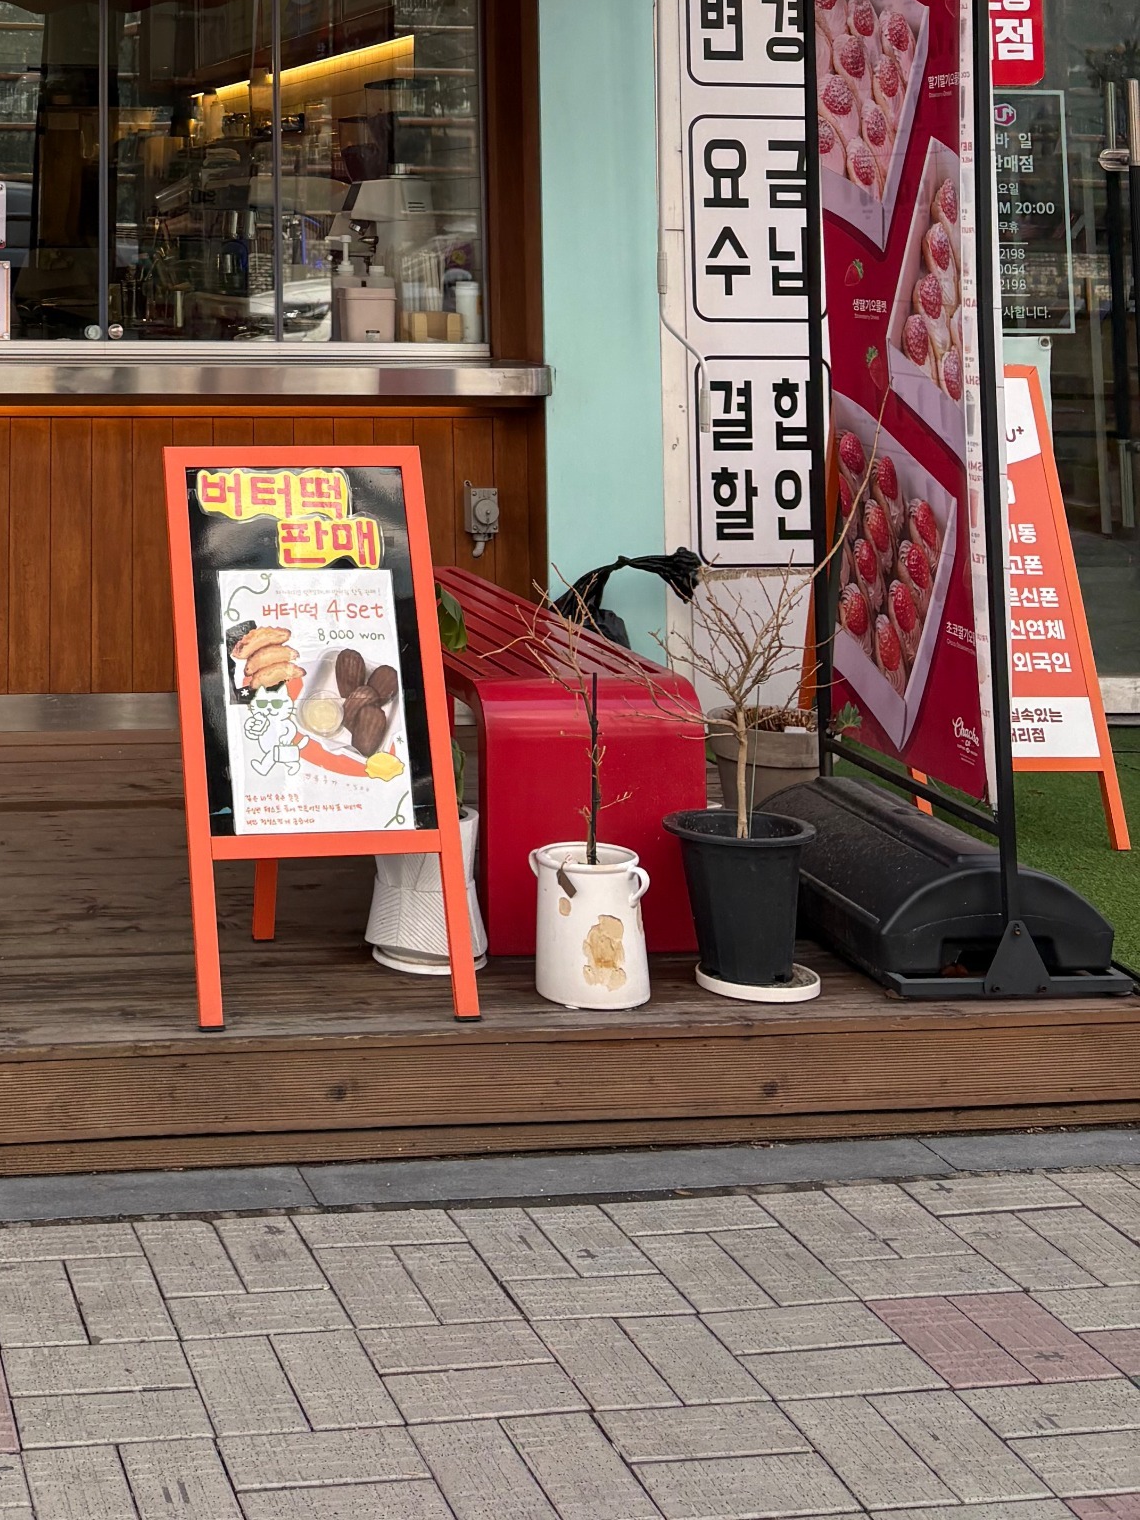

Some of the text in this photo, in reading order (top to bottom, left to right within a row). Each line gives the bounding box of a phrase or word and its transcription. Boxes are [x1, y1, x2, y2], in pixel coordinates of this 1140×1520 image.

[703, 138, 807, 209] 요금
[1015, 202, 1055, 215] 20:00
[709, 378, 811, 451] 결합
[200, 473, 343, 520] 버터떡
[711, 466, 814, 541] 할인
[280, 520, 377, 566] 판매
[262, 602, 318, 620] 버터떡
[317, 628, 386, 645] 8,000 won
[1012, 652, 1073, 673] 외국인
